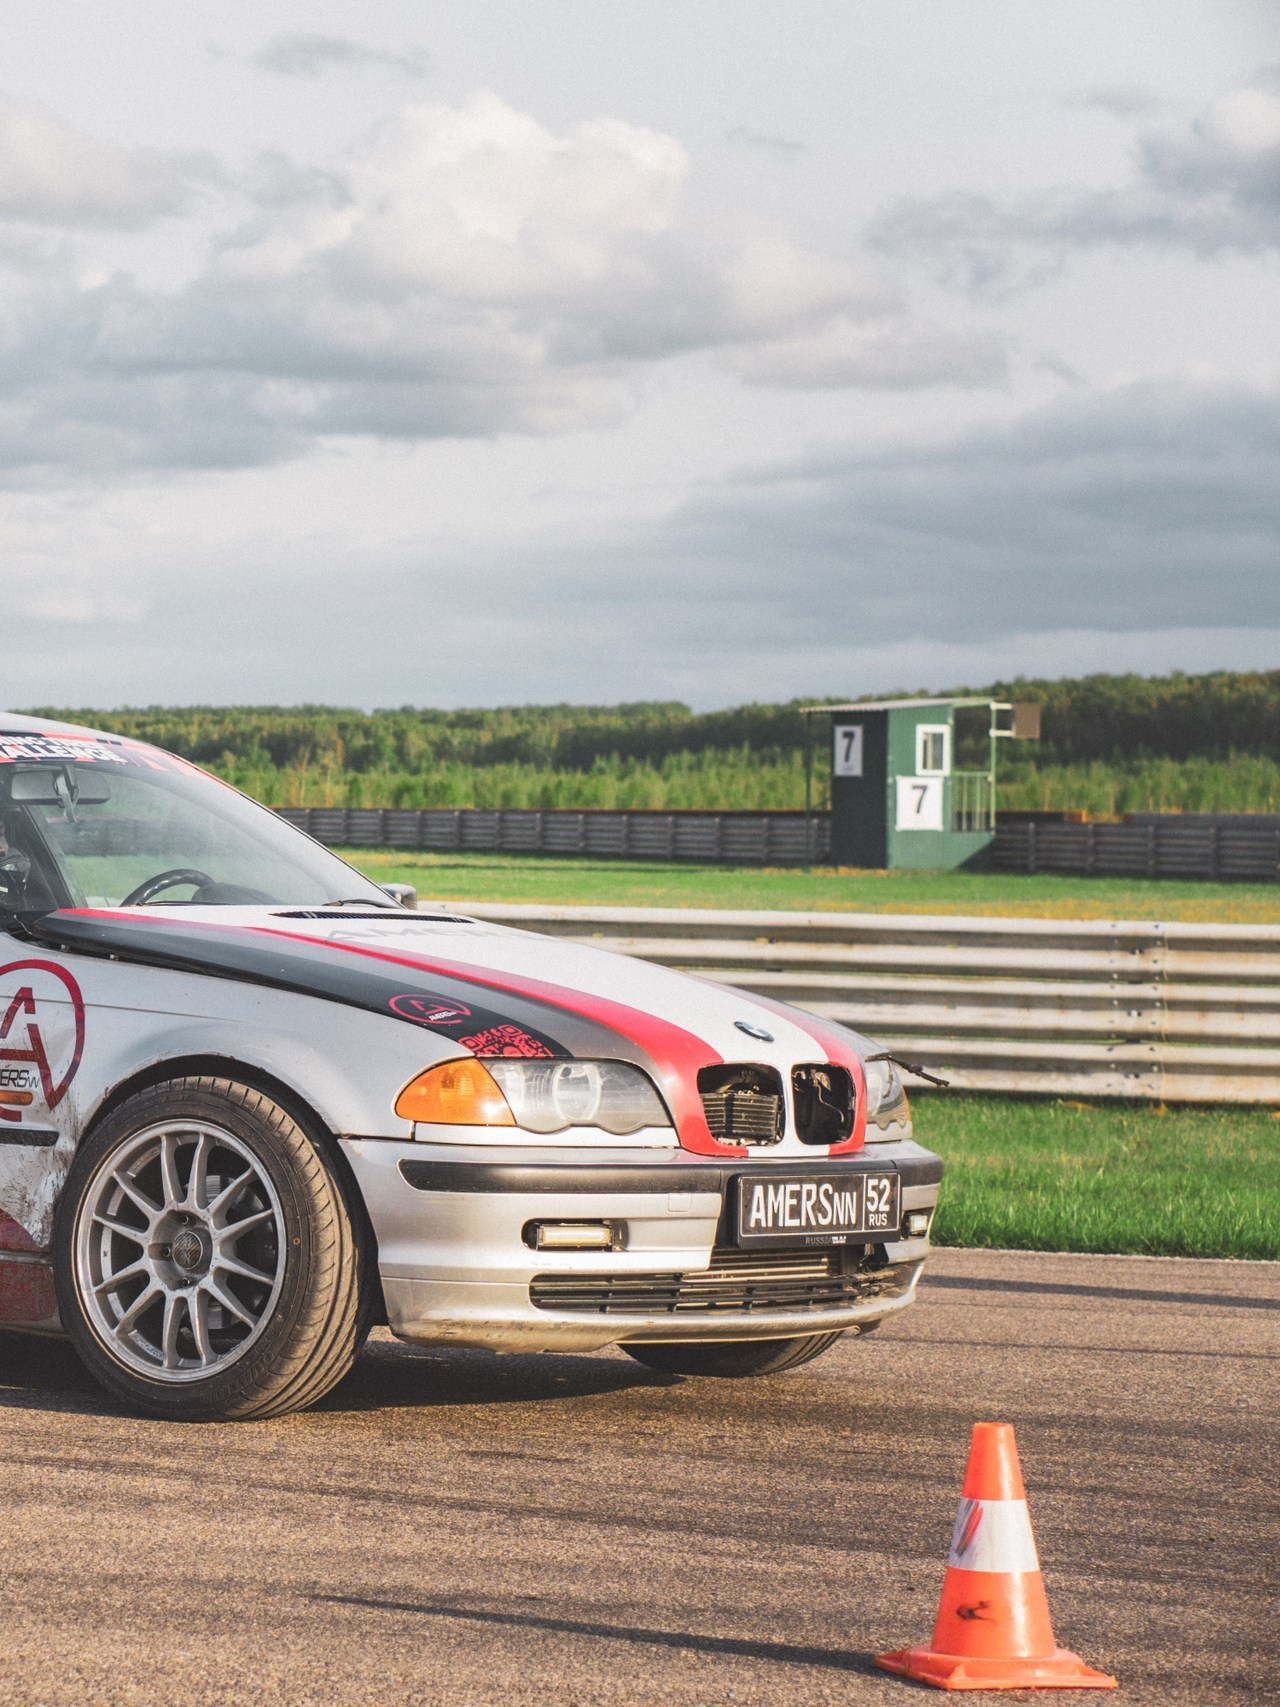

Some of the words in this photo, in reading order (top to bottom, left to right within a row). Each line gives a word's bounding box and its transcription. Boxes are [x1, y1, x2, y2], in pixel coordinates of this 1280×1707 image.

[842, 731, 855, 762] 7
[912, 785, 928, 814] 7
[866, 1178, 891, 1212] 52
[869, 1213, 888, 1227] RUS
